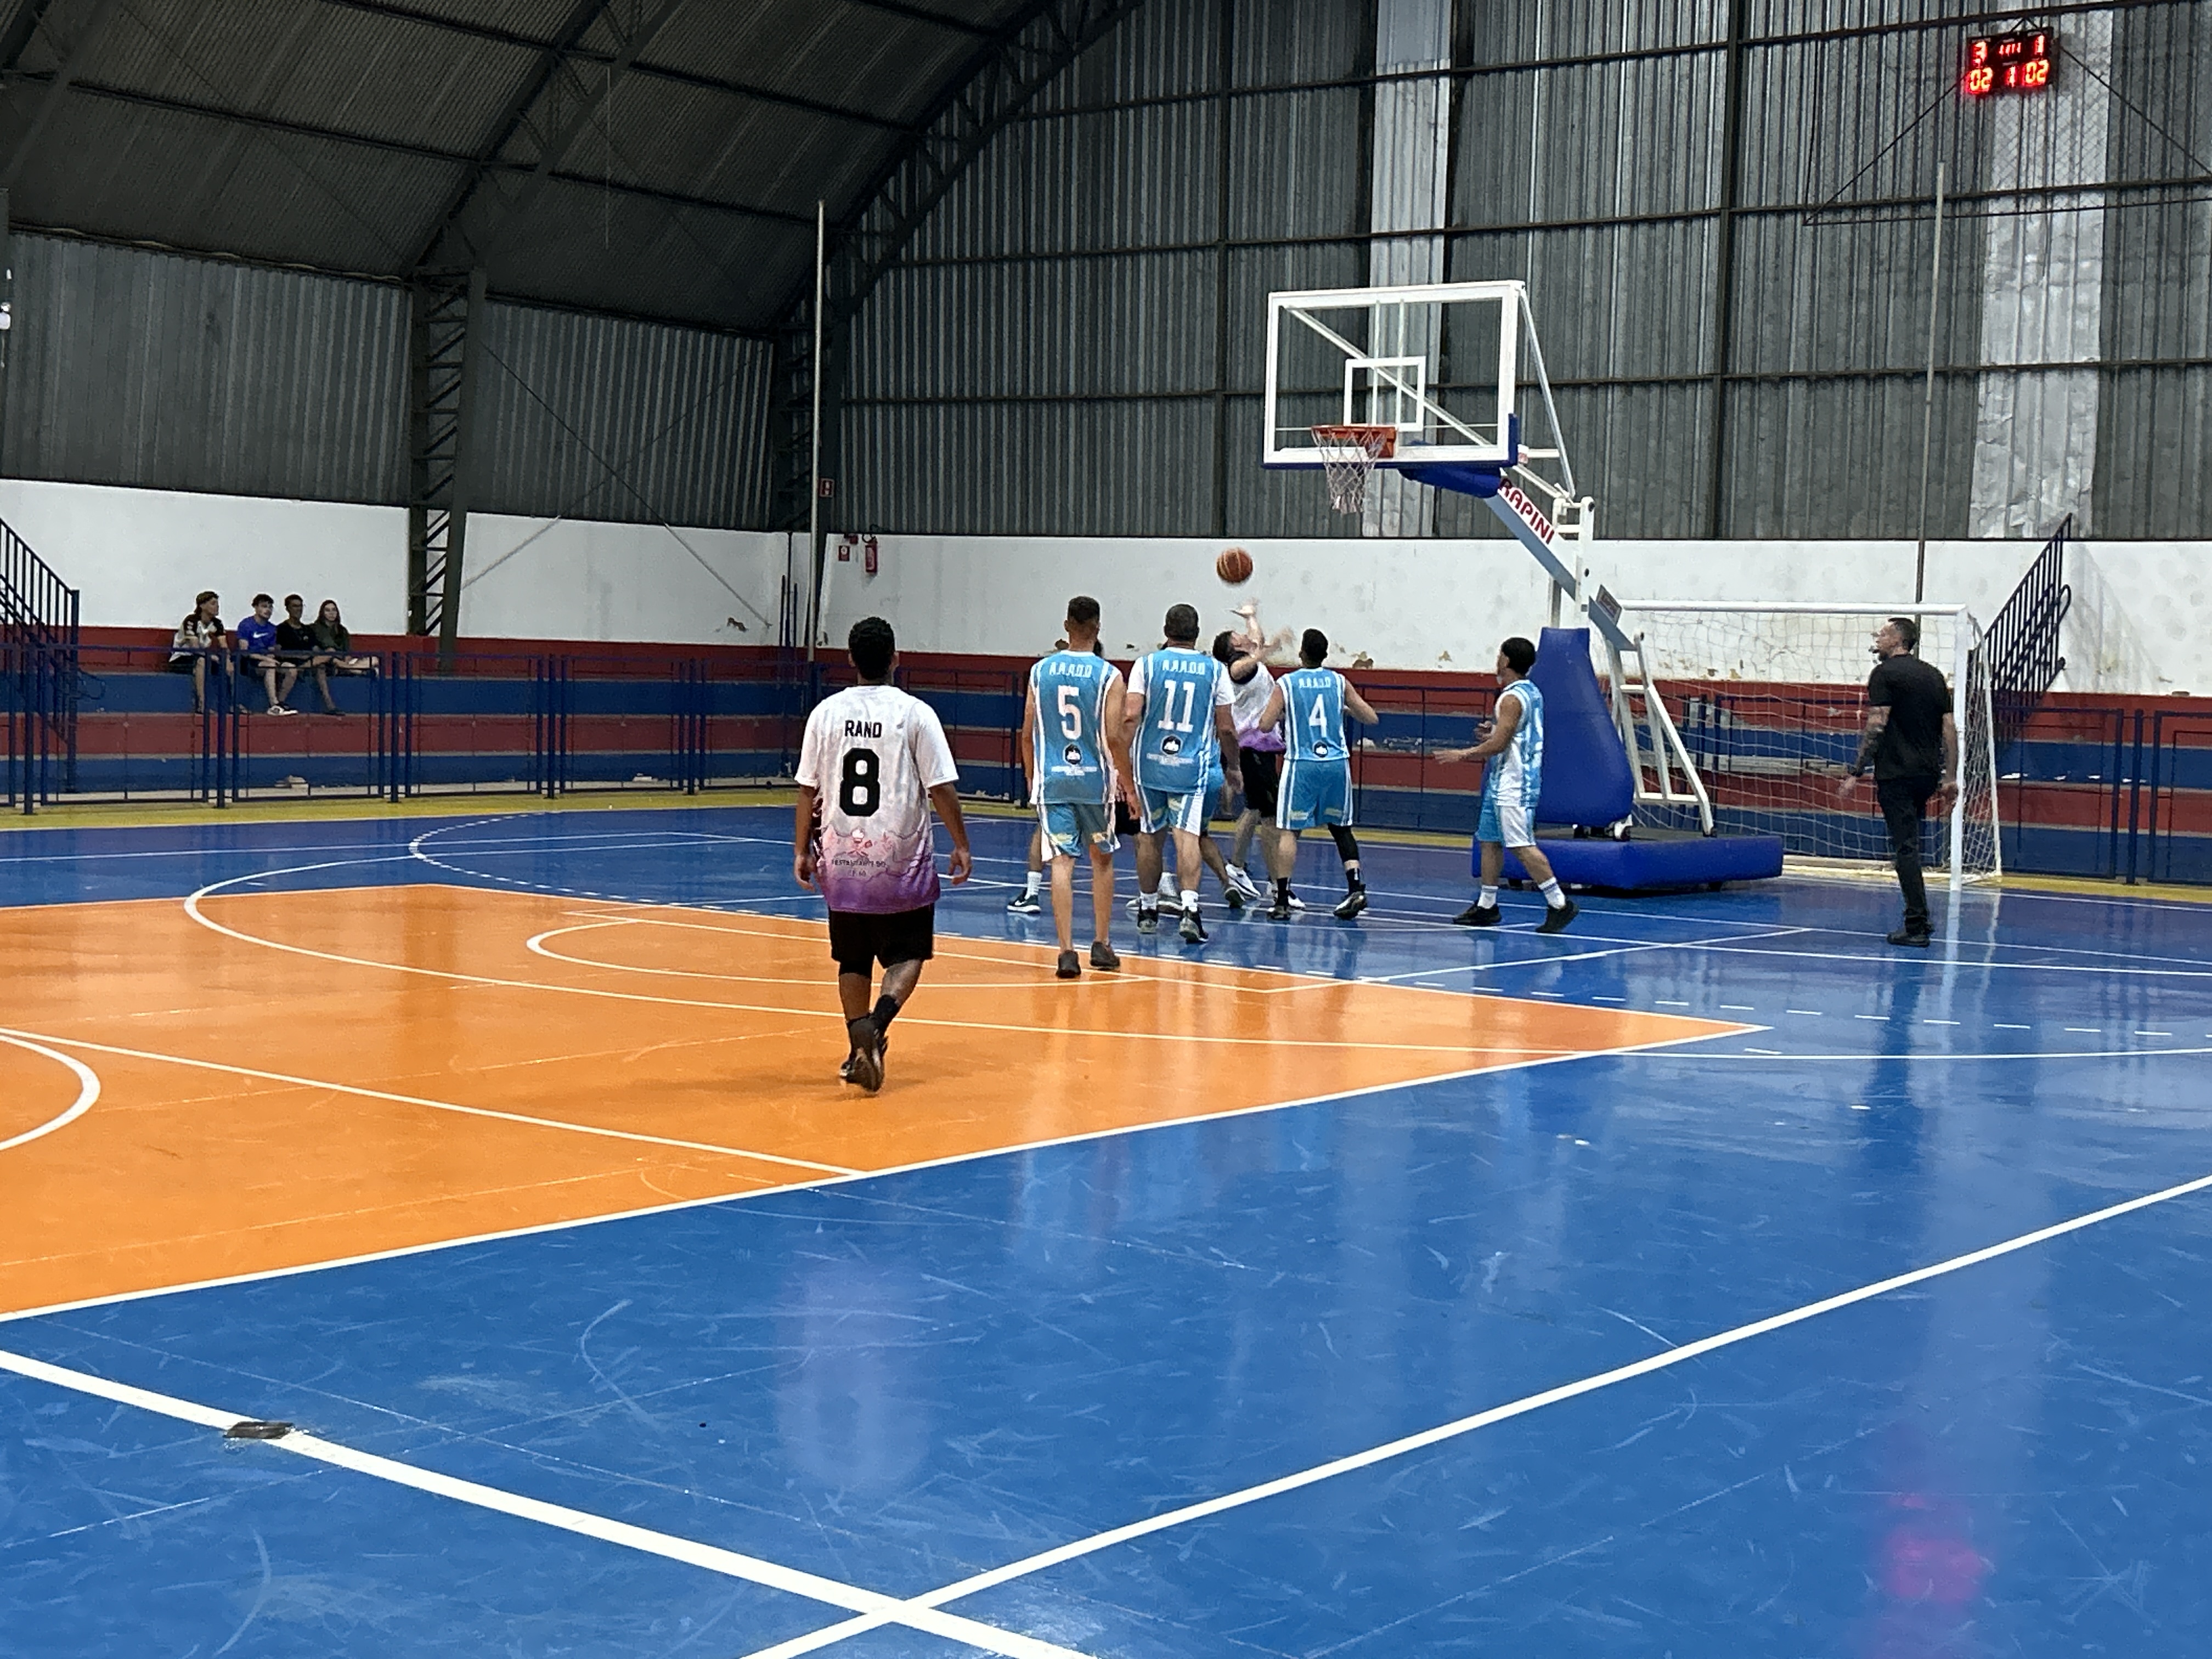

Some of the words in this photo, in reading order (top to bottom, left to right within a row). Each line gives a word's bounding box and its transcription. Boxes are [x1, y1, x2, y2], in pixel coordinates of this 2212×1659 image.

[1970, 67, 1993, 92] 02
[2025, 59, 2049, 85] 02
[1499, 478, 1554, 545] RAPINI
[1058, 685, 1081, 740] 5
[1158, 679, 1196, 733] 11
[1309, 693, 1328, 738] 4
[839, 747, 881, 817] 8
